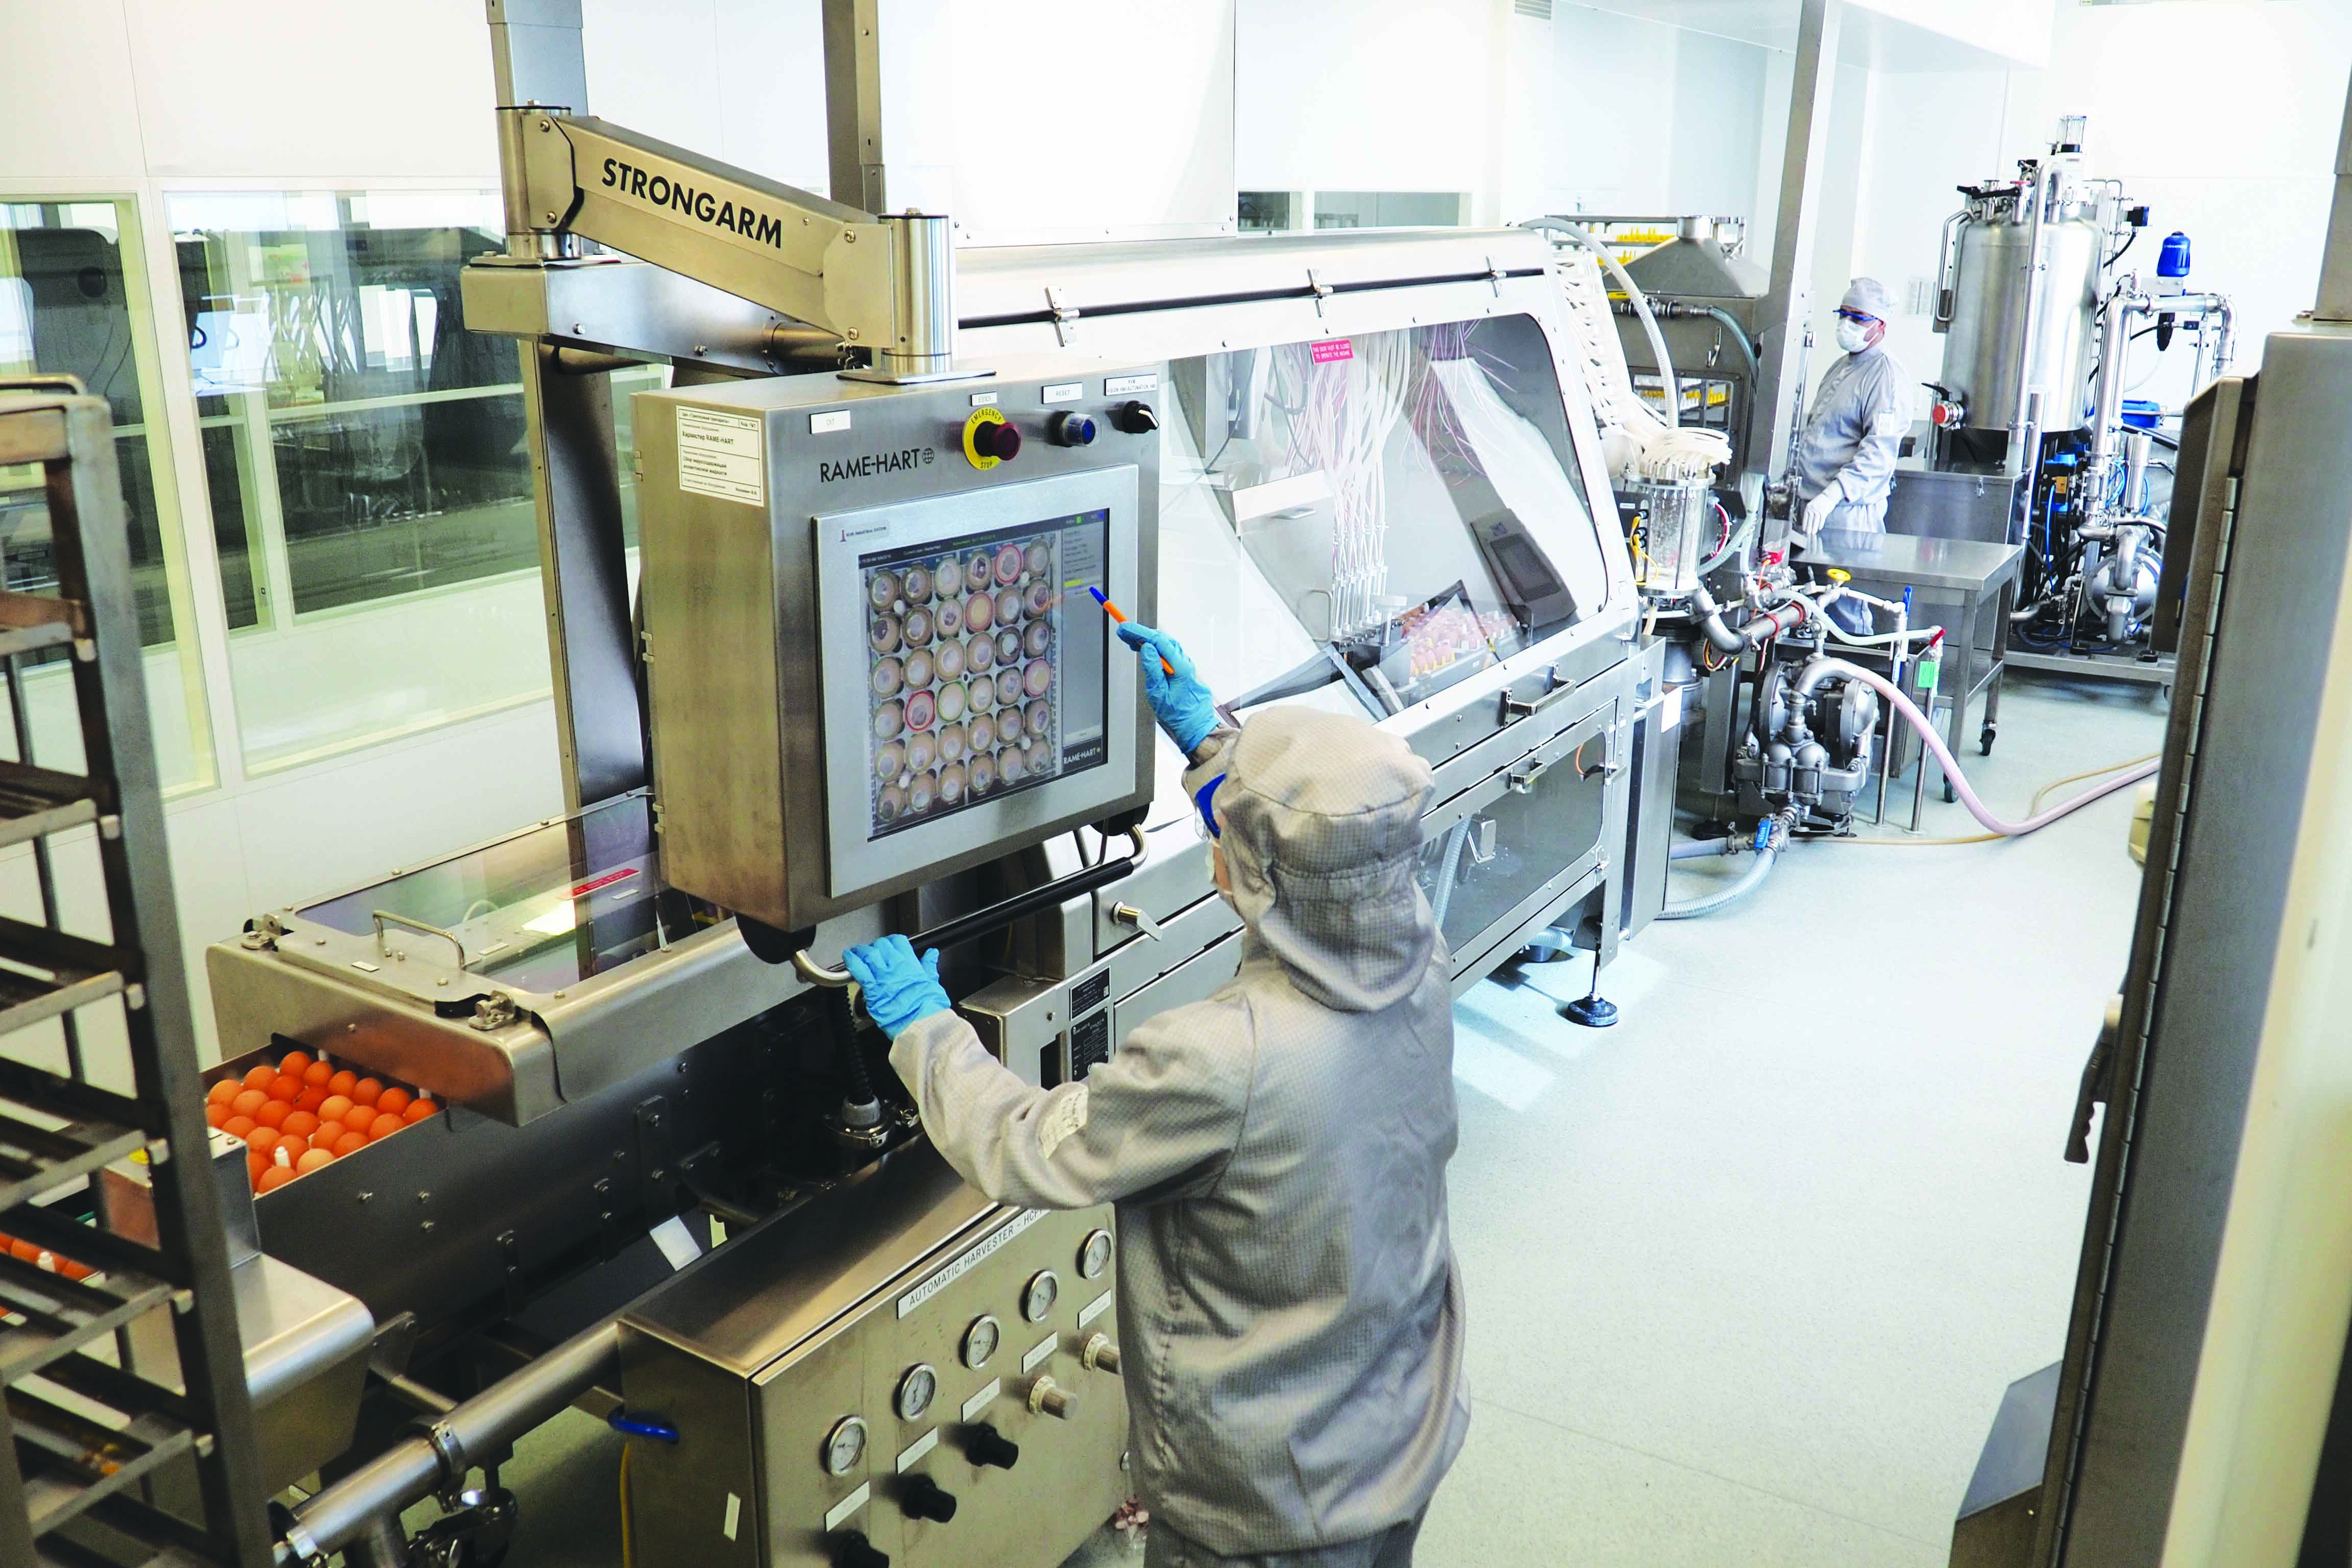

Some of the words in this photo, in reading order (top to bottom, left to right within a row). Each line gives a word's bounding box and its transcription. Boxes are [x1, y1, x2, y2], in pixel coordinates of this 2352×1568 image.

[602, 158, 782, 249] STRONGARM
[970, 408, 1002, 424] EMERGENCY
[706, 434, 734, 445] RAME-HART
[820, 448, 920, 482] RAME-HART
[1063, 747, 1095, 764] RAME-HART
[909, 1263, 960, 1307] AUTOMATIC
[964, 1225, 1014, 1268] HARVESTER
